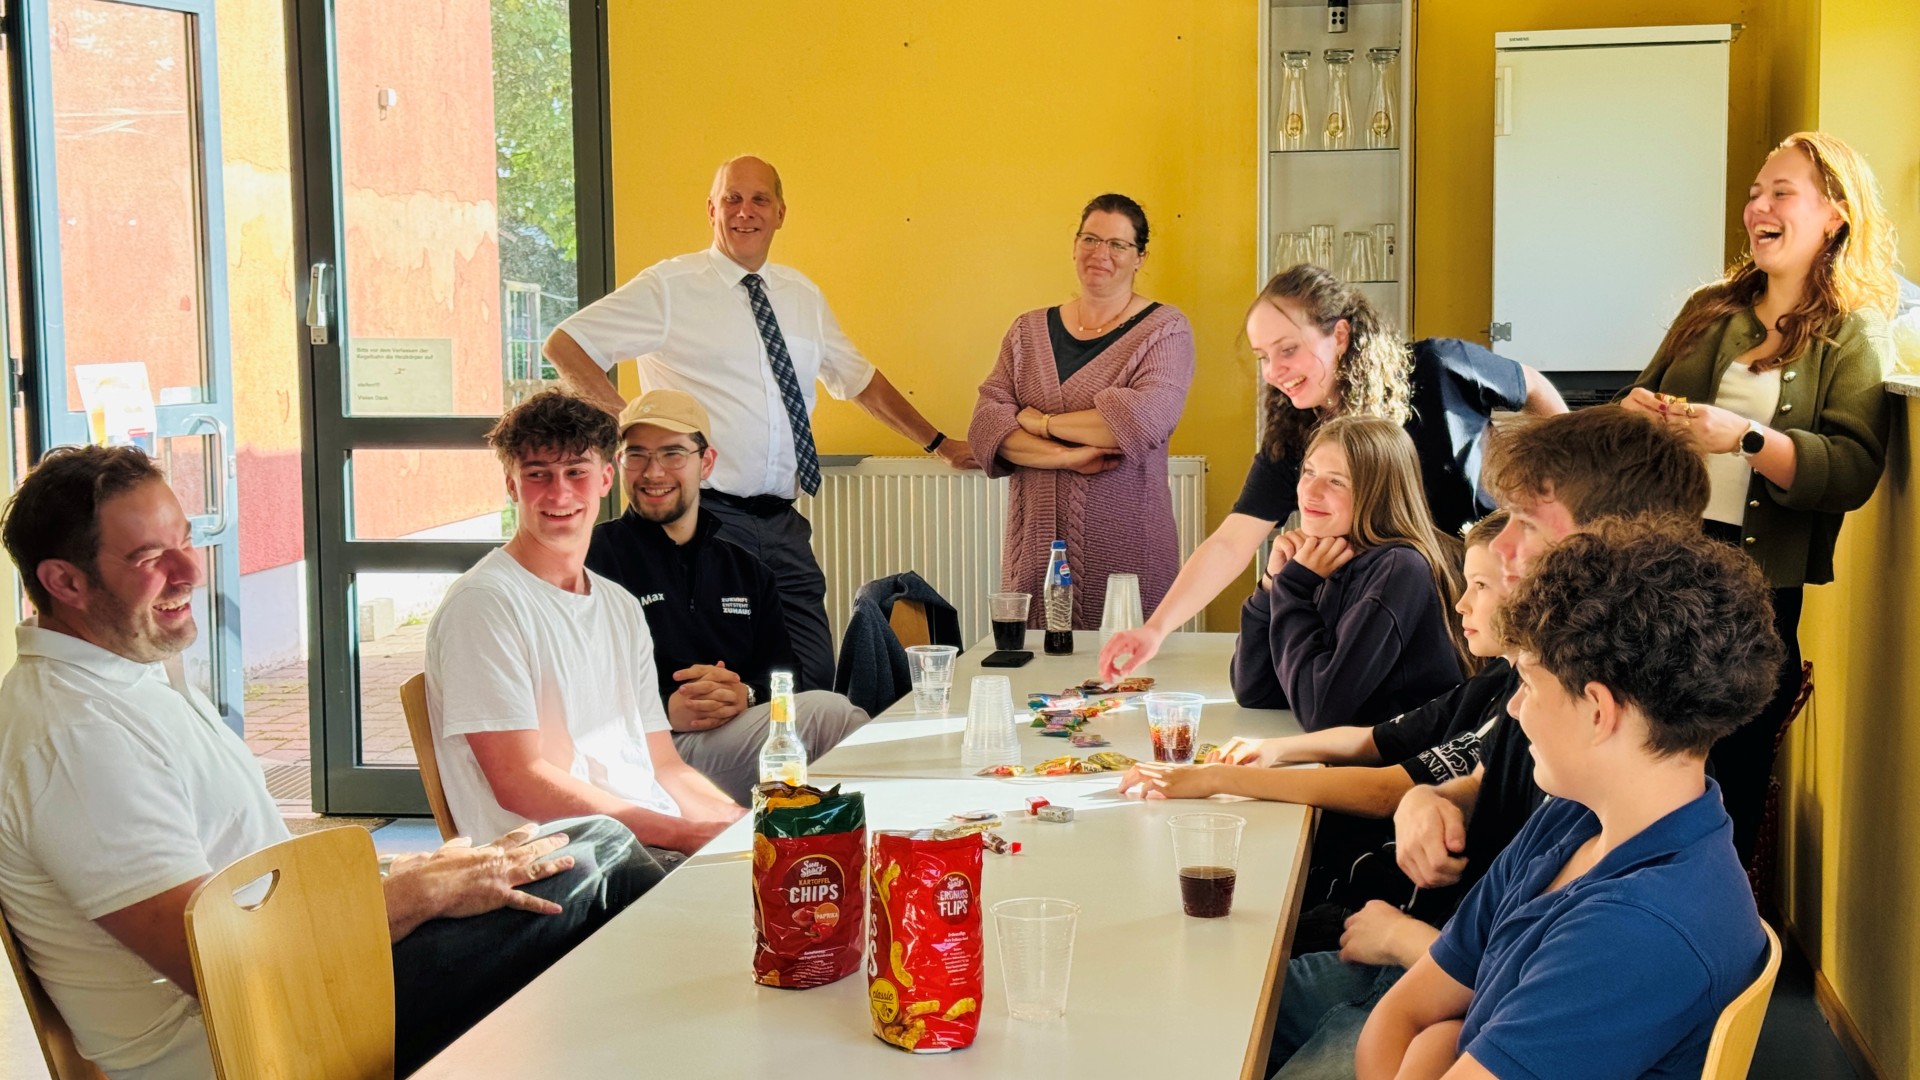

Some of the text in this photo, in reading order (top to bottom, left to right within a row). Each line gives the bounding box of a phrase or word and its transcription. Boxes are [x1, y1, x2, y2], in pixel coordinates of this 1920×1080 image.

[641, 592, 665, 607] Max
[798, 877, 831, 886] KARTOFFEL
[789, 884, 839, 904] CHIPS
[939, 889, 969, 901] ERDNUSS
[939, 899, 968, 917] FLIPS
[816, 912, 839, 920] PAPRIKA
[873, 989, 894, 1001] classic
